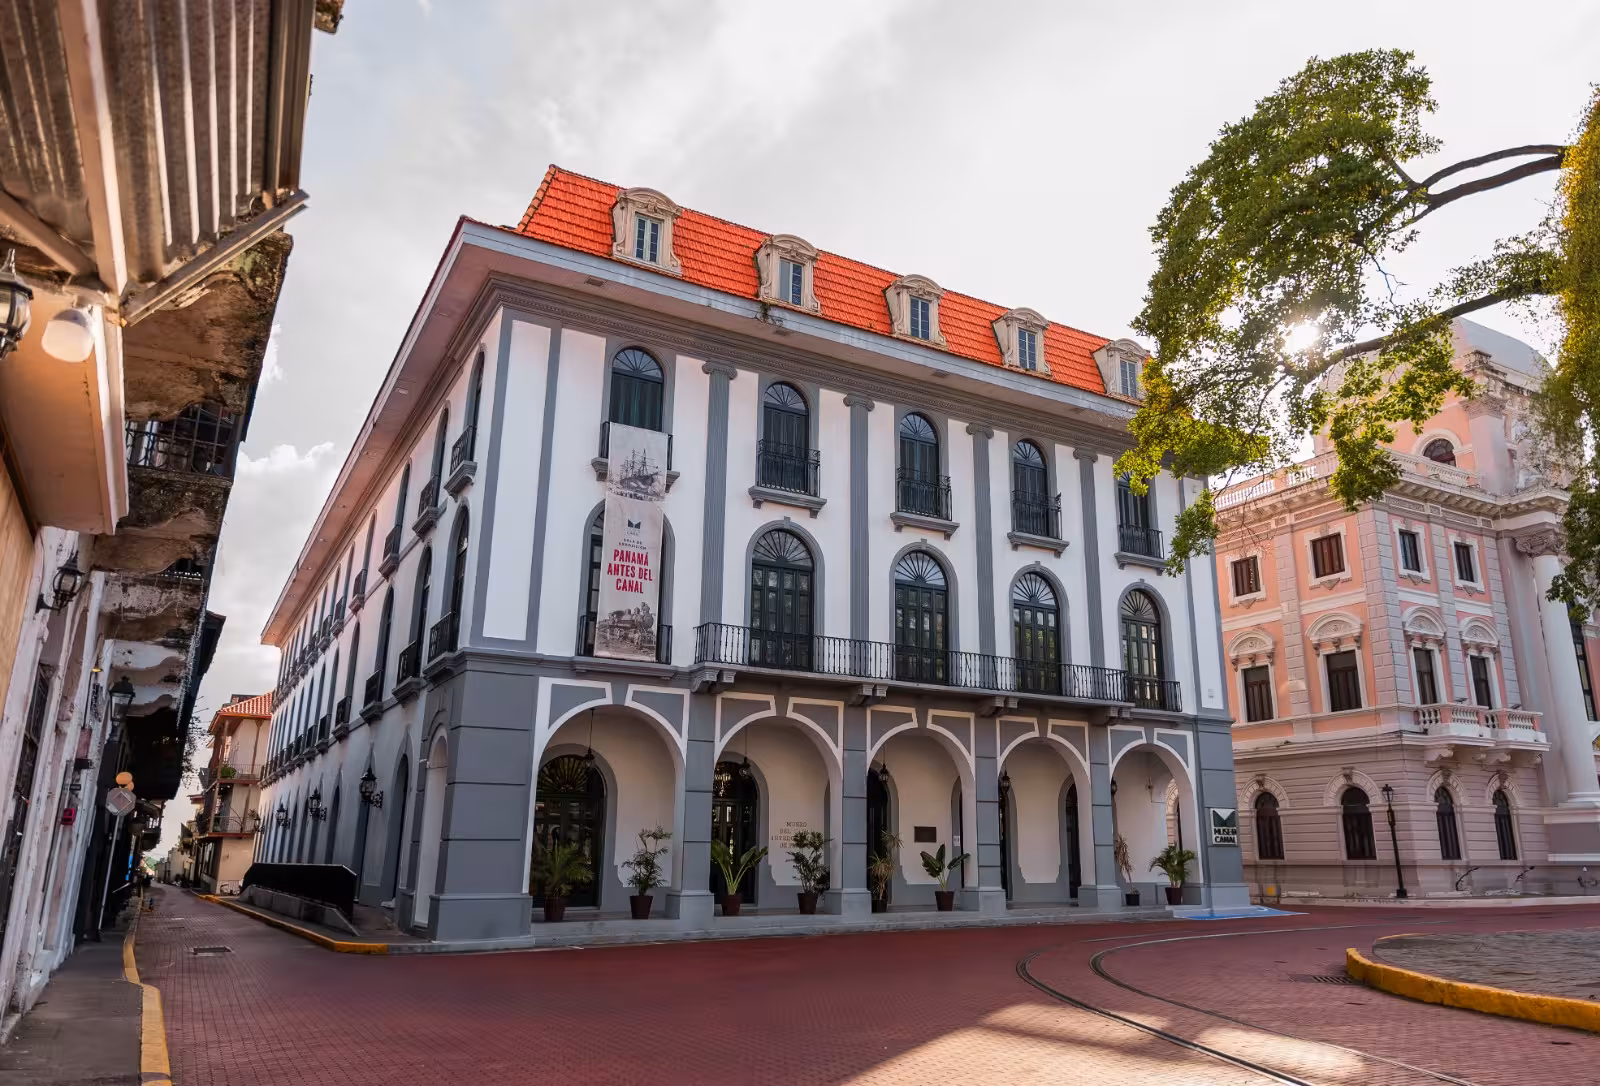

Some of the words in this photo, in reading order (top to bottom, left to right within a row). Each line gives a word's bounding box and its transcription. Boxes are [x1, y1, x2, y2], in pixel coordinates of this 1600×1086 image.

[613, 549, 649, 566] PANAMÁ
[607, 563, 636, 578] ANTES
[638, 567, 653, 581] DEL
[616, 578, 644, 594] CANAL
